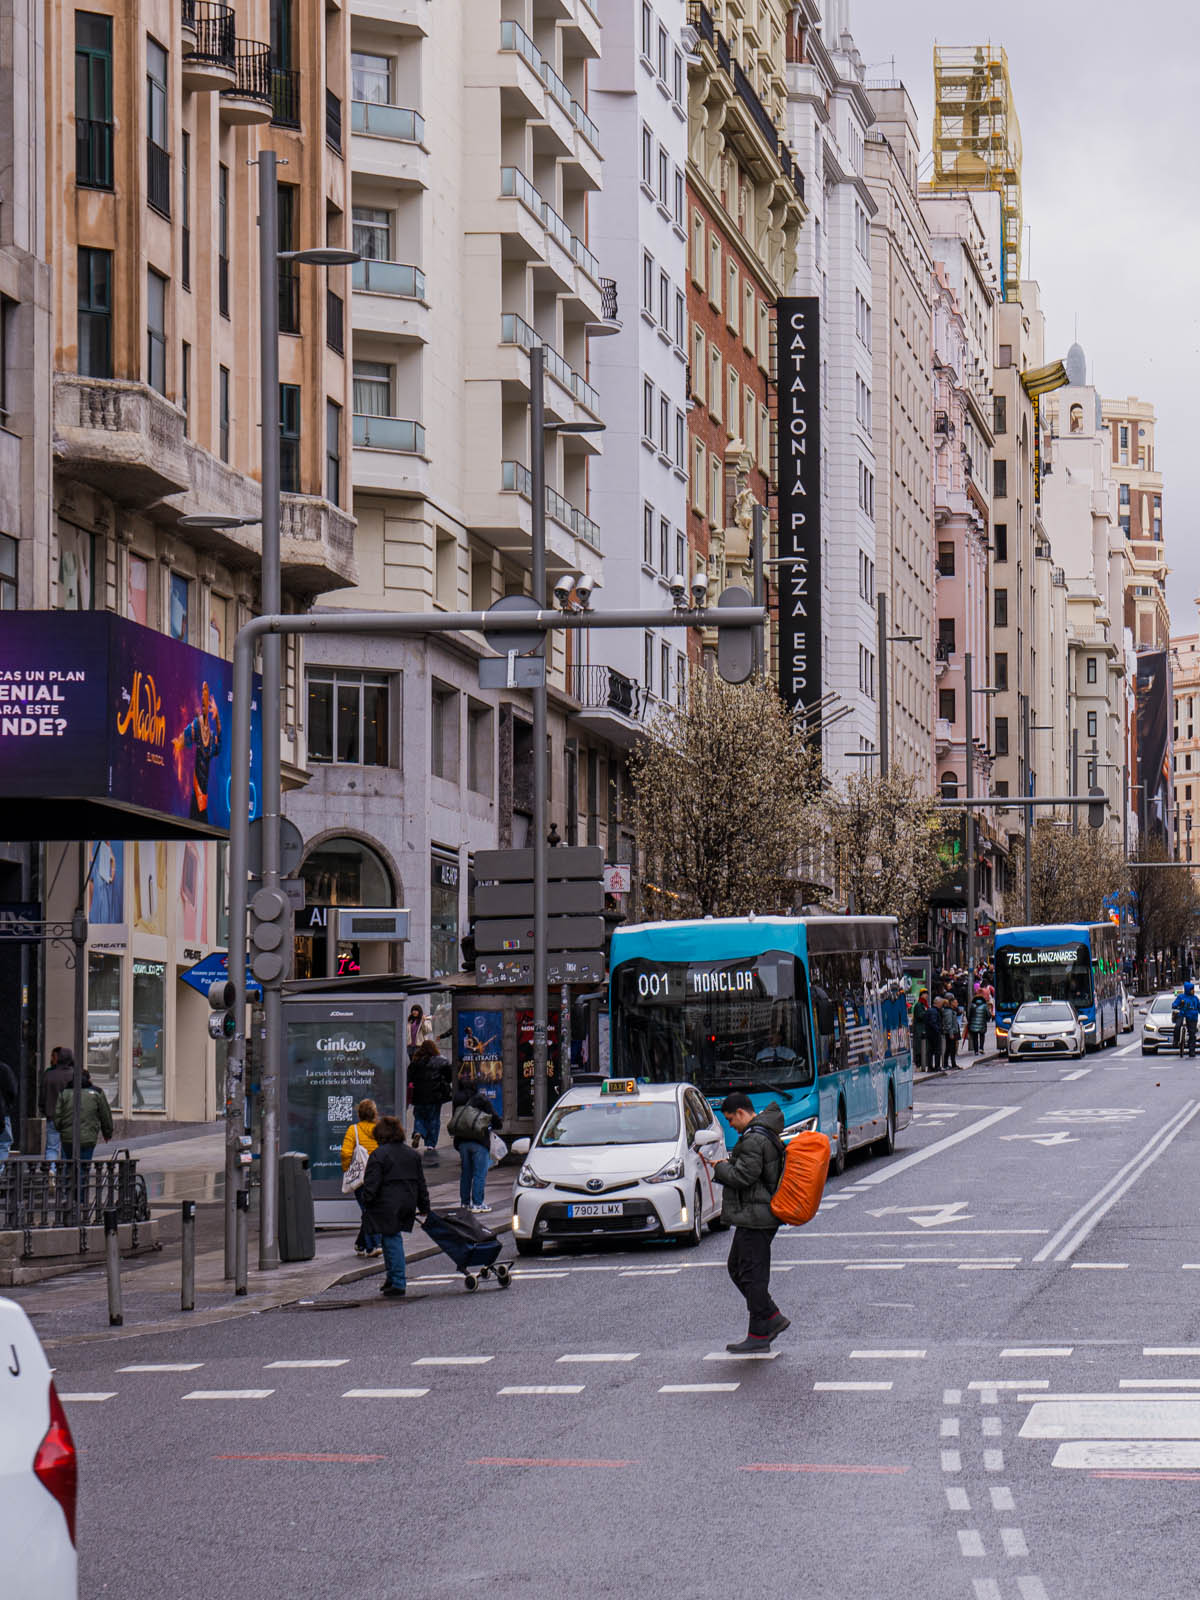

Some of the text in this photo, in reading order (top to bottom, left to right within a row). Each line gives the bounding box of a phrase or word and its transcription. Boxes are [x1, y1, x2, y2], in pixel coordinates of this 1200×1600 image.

[790, 313, 806, 496] CATALONIA
[791, 513, 807, 617] PLAZA
[25, 671, 45, 681] UN
[49, 671, 85, 681] PLAN
[26, 704, 60, 715] ESTE
[183, 948, 202, 960] CREATE
[1006, 950, 1078, 965] 75 COL. MANZANARES
[638, 971, 753, 996] 001 MONCLOA
[316, 1038, 366, 1052] Ginkgo
[305, 1068, 375, 1077] La excelencia del Sushi
[349, 1077, 372, 1085] Madrid
[609, 1081, 634, 1093] TAXI 2
[574, 1204, 620, 1216] 7902 LMX
